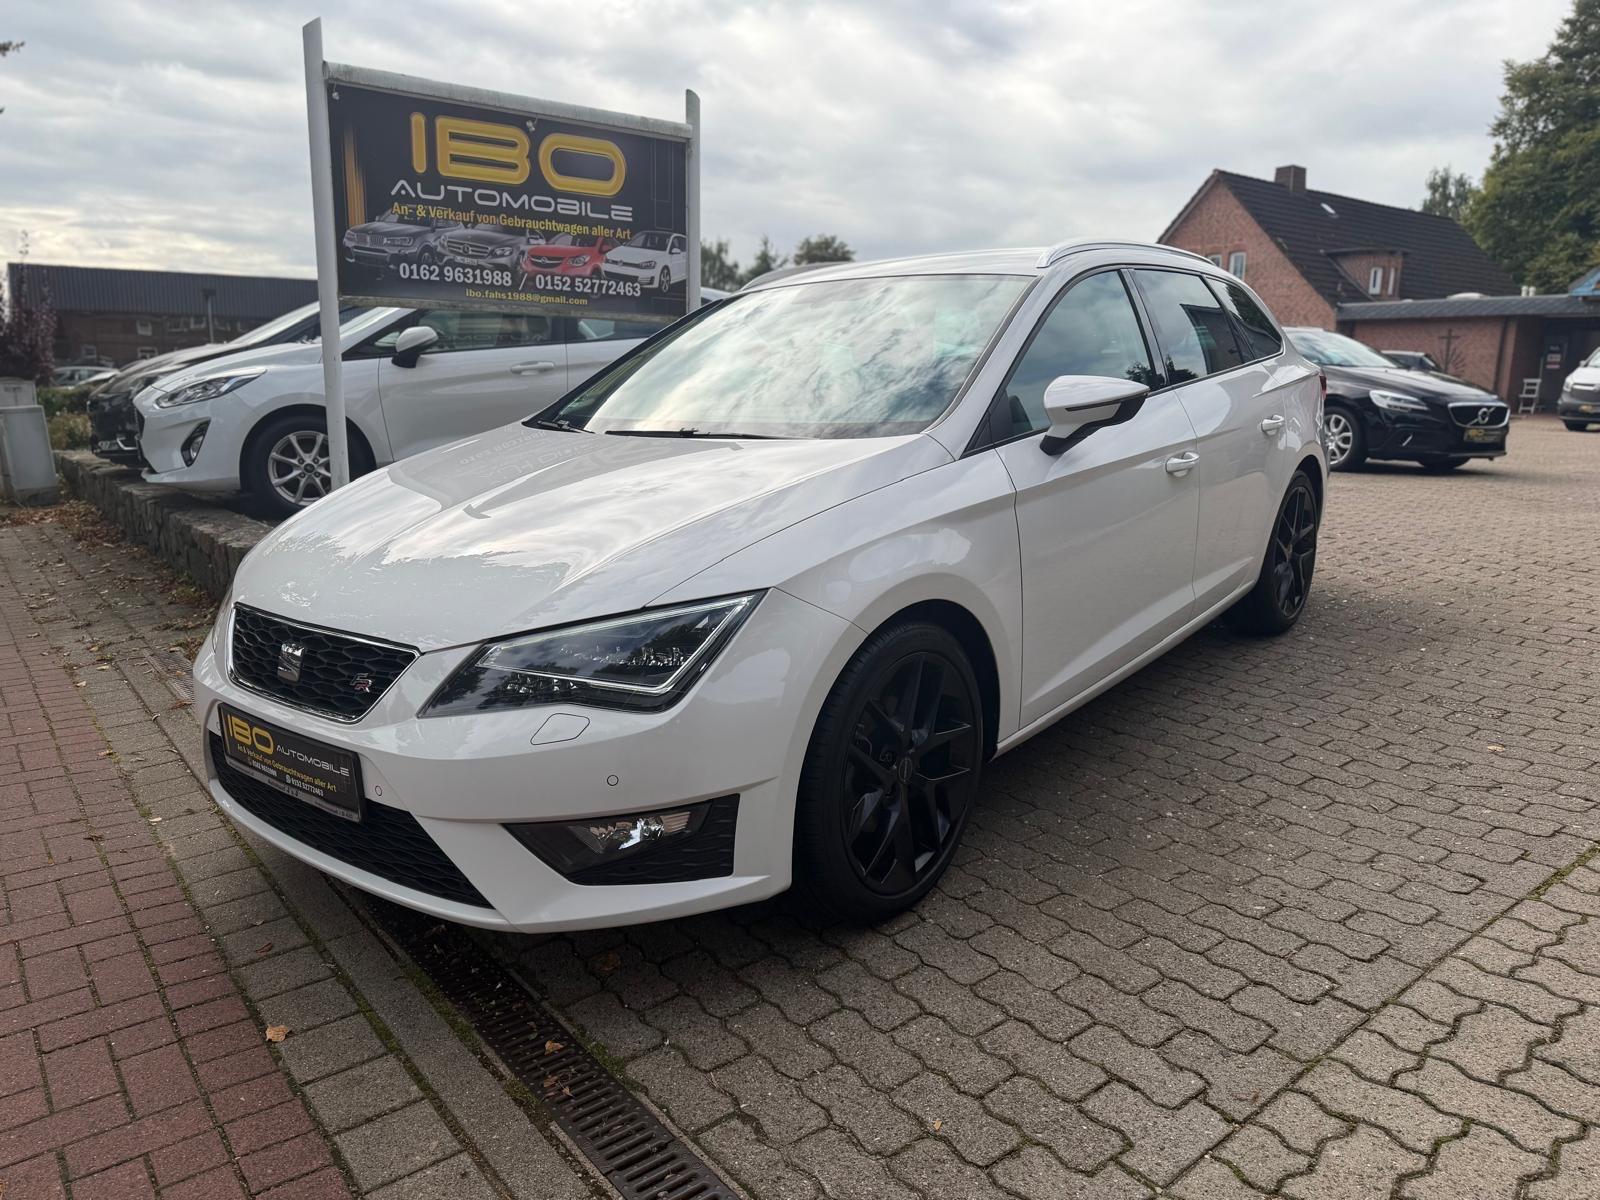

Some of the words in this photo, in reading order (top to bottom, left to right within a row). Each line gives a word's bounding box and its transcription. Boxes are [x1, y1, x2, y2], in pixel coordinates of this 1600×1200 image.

[410, 111, 627, 198] IBO
[391, 179, 633, 222] AUTOMOBILE
[392, 202, 414, 216] An-
[415, 204, 427, 217] &
[428, 206, 476, 223] Verkauf
[476, 213, 497, 224] von
[499, 213, 592, 237] Gebrauchtwagen
[592, 225, 614, 238] aller
[615, 228, 631, 240] Art
[399, 262, 440, 281] 0162
[443, 266, 513, 287] 9631988
[535, 274, 571, 292] 0152
[574, 277, 642, 298] 52772463
[227, 713, 275, 756] IBO
[276, 744, 350, 777] AUTOMOBILE
[326, 780, 337, 793] Art
